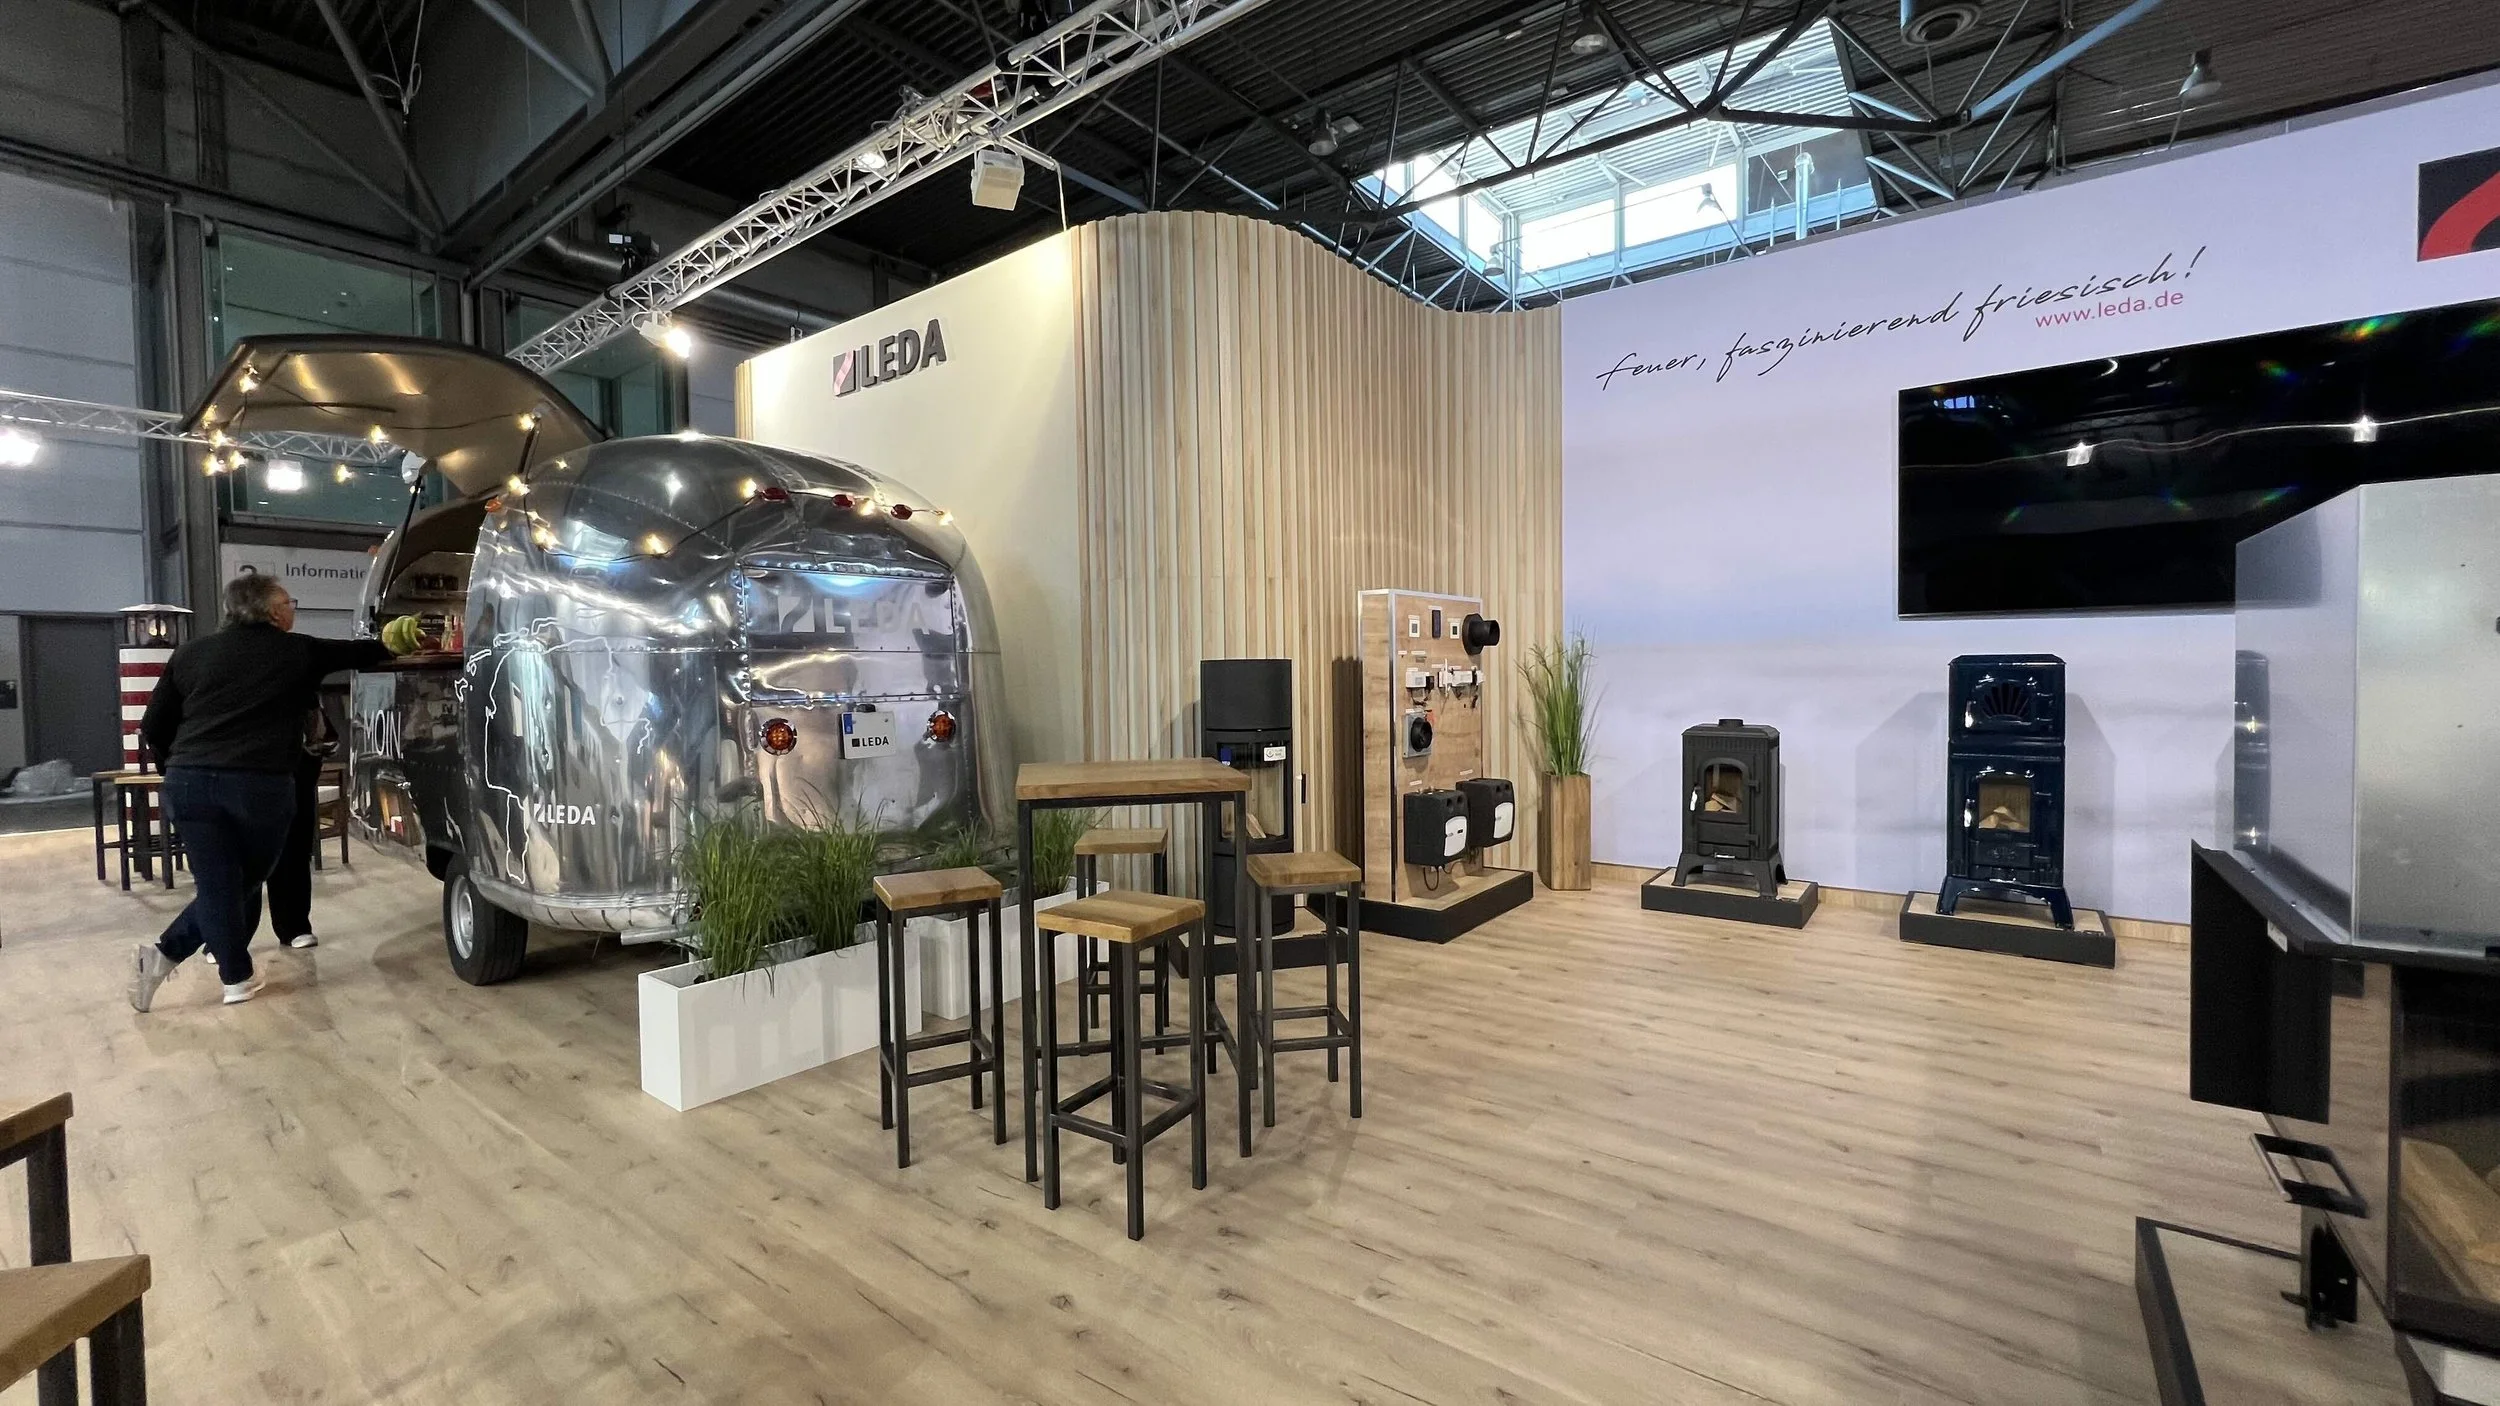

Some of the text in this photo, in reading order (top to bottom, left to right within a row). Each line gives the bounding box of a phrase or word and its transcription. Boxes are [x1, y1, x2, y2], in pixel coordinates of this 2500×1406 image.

[1596, 245, 2207, 391] feuer, faszinierend friesisch!
[2035, 290, 2184, 328] www.leda.de
[861, 318, 947, 388] LEDA
[823, 597, 931, 636] LEDA
[861, 735, 890, 747] LEDA
[547, 803, 597, 826] LEDA
